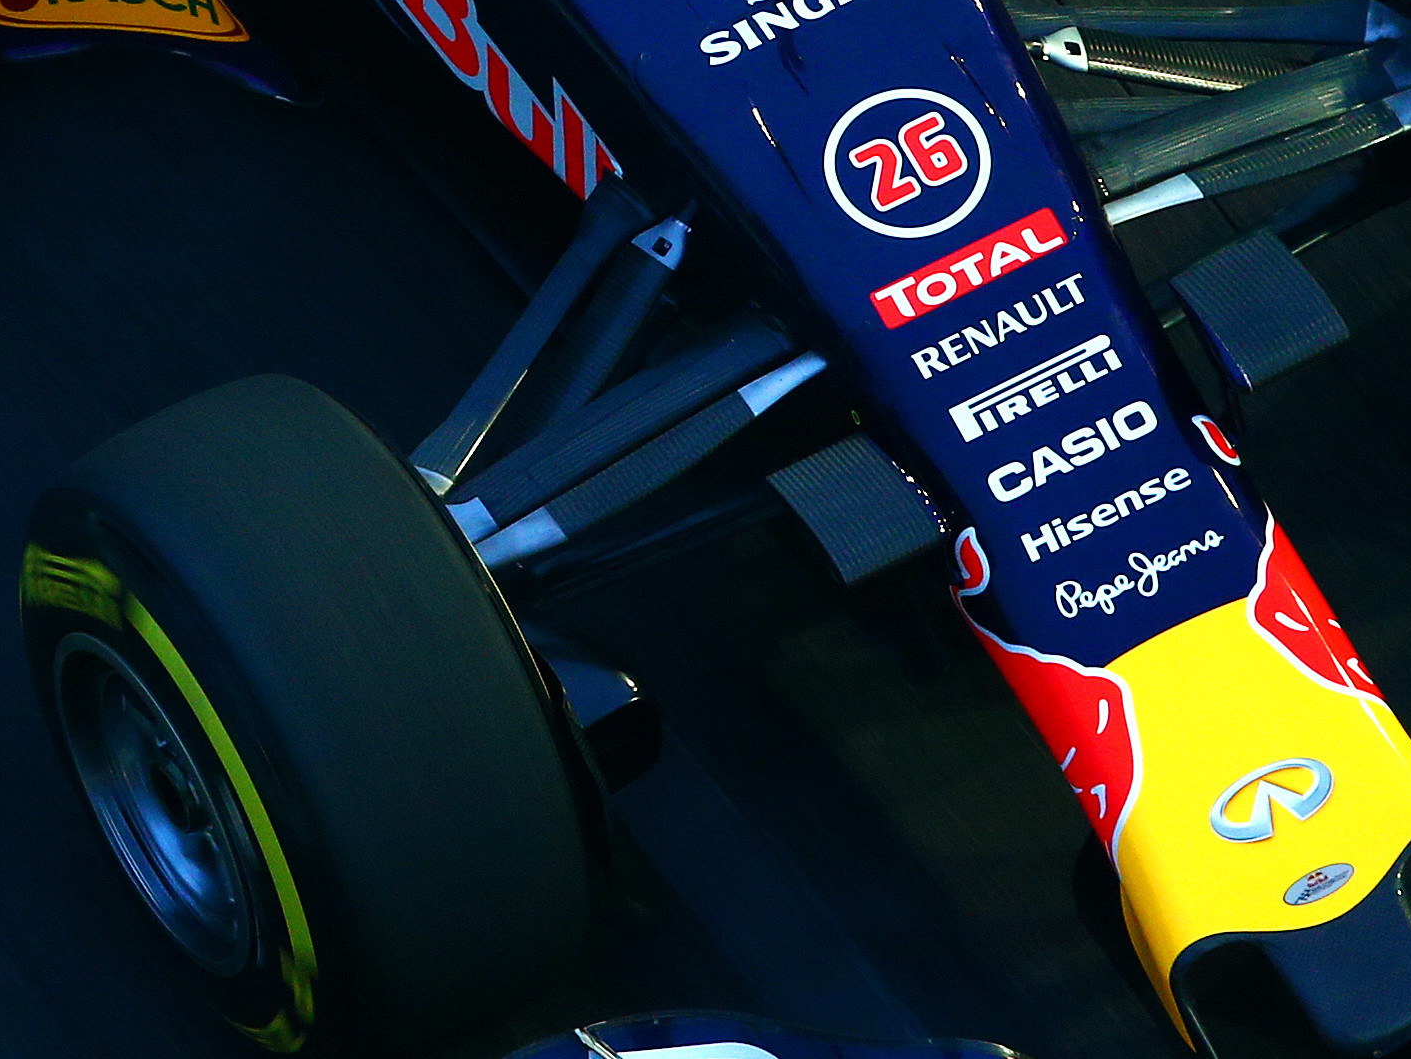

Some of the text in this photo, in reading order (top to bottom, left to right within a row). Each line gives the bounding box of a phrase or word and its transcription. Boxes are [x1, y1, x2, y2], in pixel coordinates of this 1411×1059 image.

[848, 111, 968, 212] 26
[874, 228, 1065, 319] TOTAL
[910, 272, 1087, 381] RENAULT
[948, 334, 1123, 443] PIRELLI
[987, 400, 1158, 503] CASIO
[1020, 466, 1193, 563] Hisense
[1054, 529, 1225, 618] Pepe Jeans
